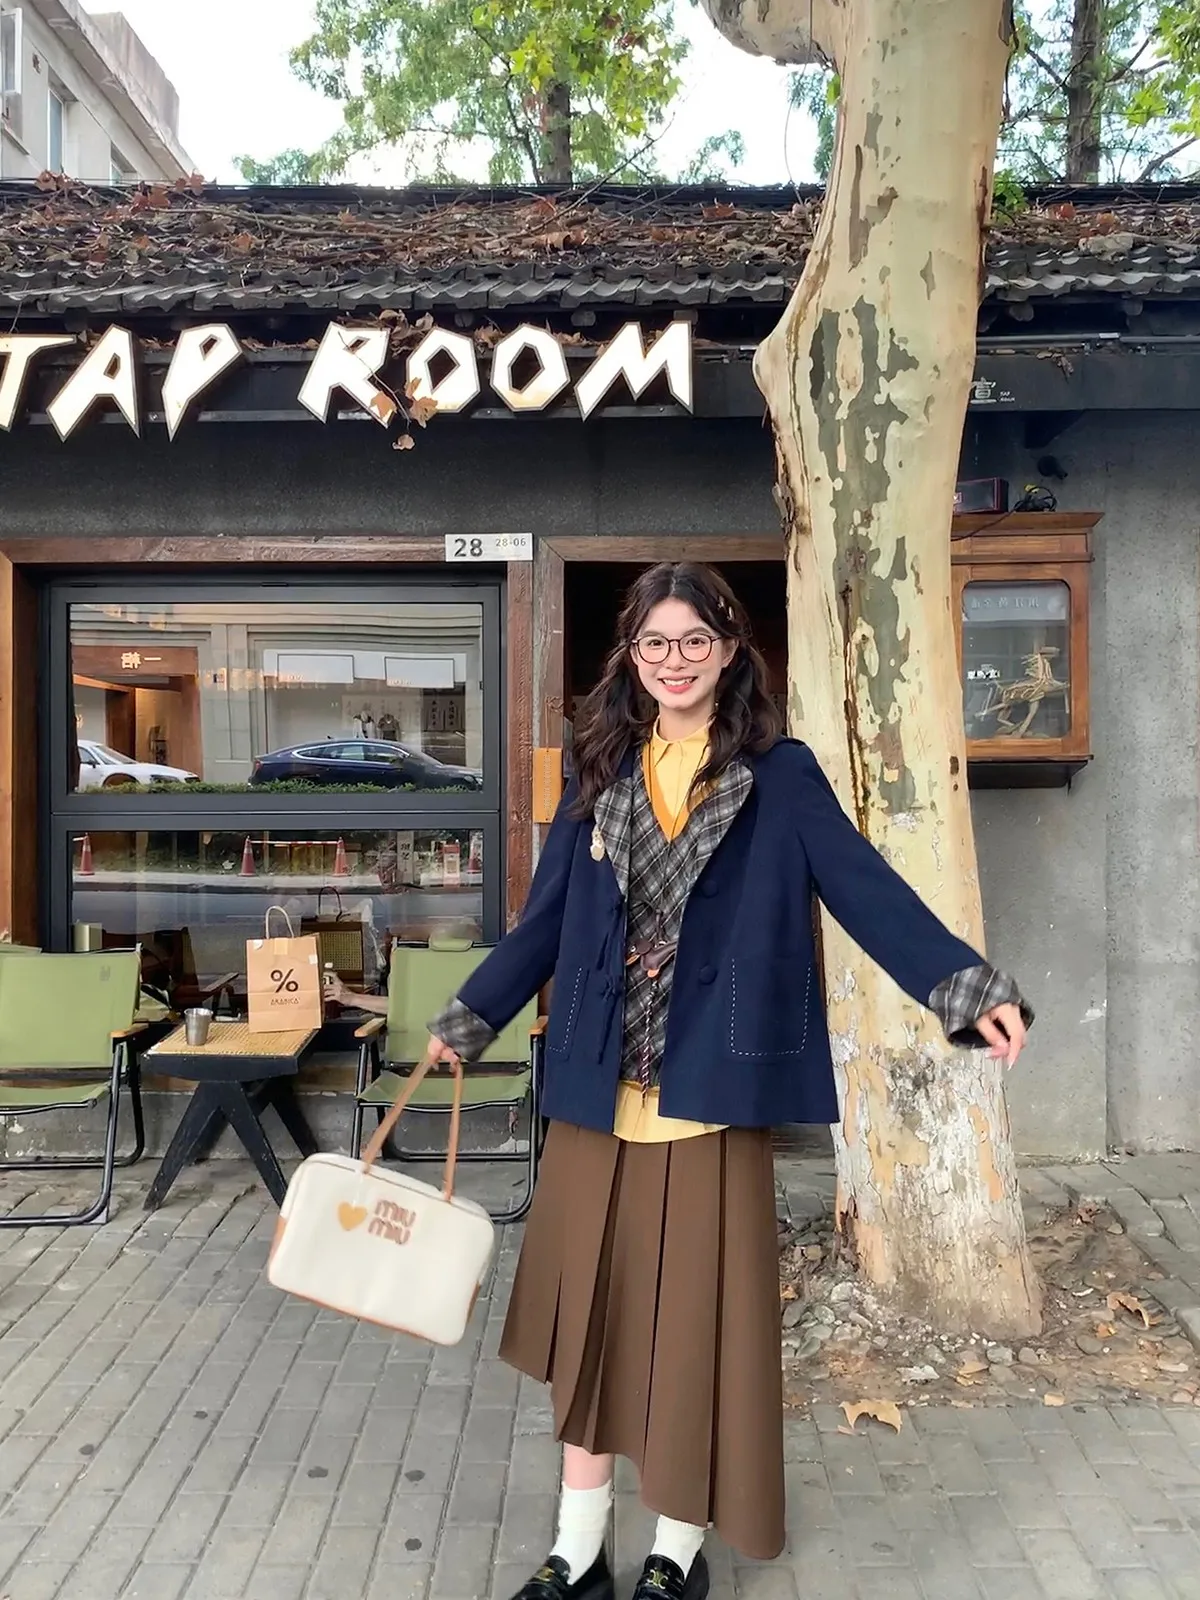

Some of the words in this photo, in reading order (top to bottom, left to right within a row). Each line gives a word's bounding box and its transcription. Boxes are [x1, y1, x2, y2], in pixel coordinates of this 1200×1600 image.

[0, 323, 242, 442] TAP
[297, 321, 694, 429] ROOM
[454, 538, 483, 557] 28
